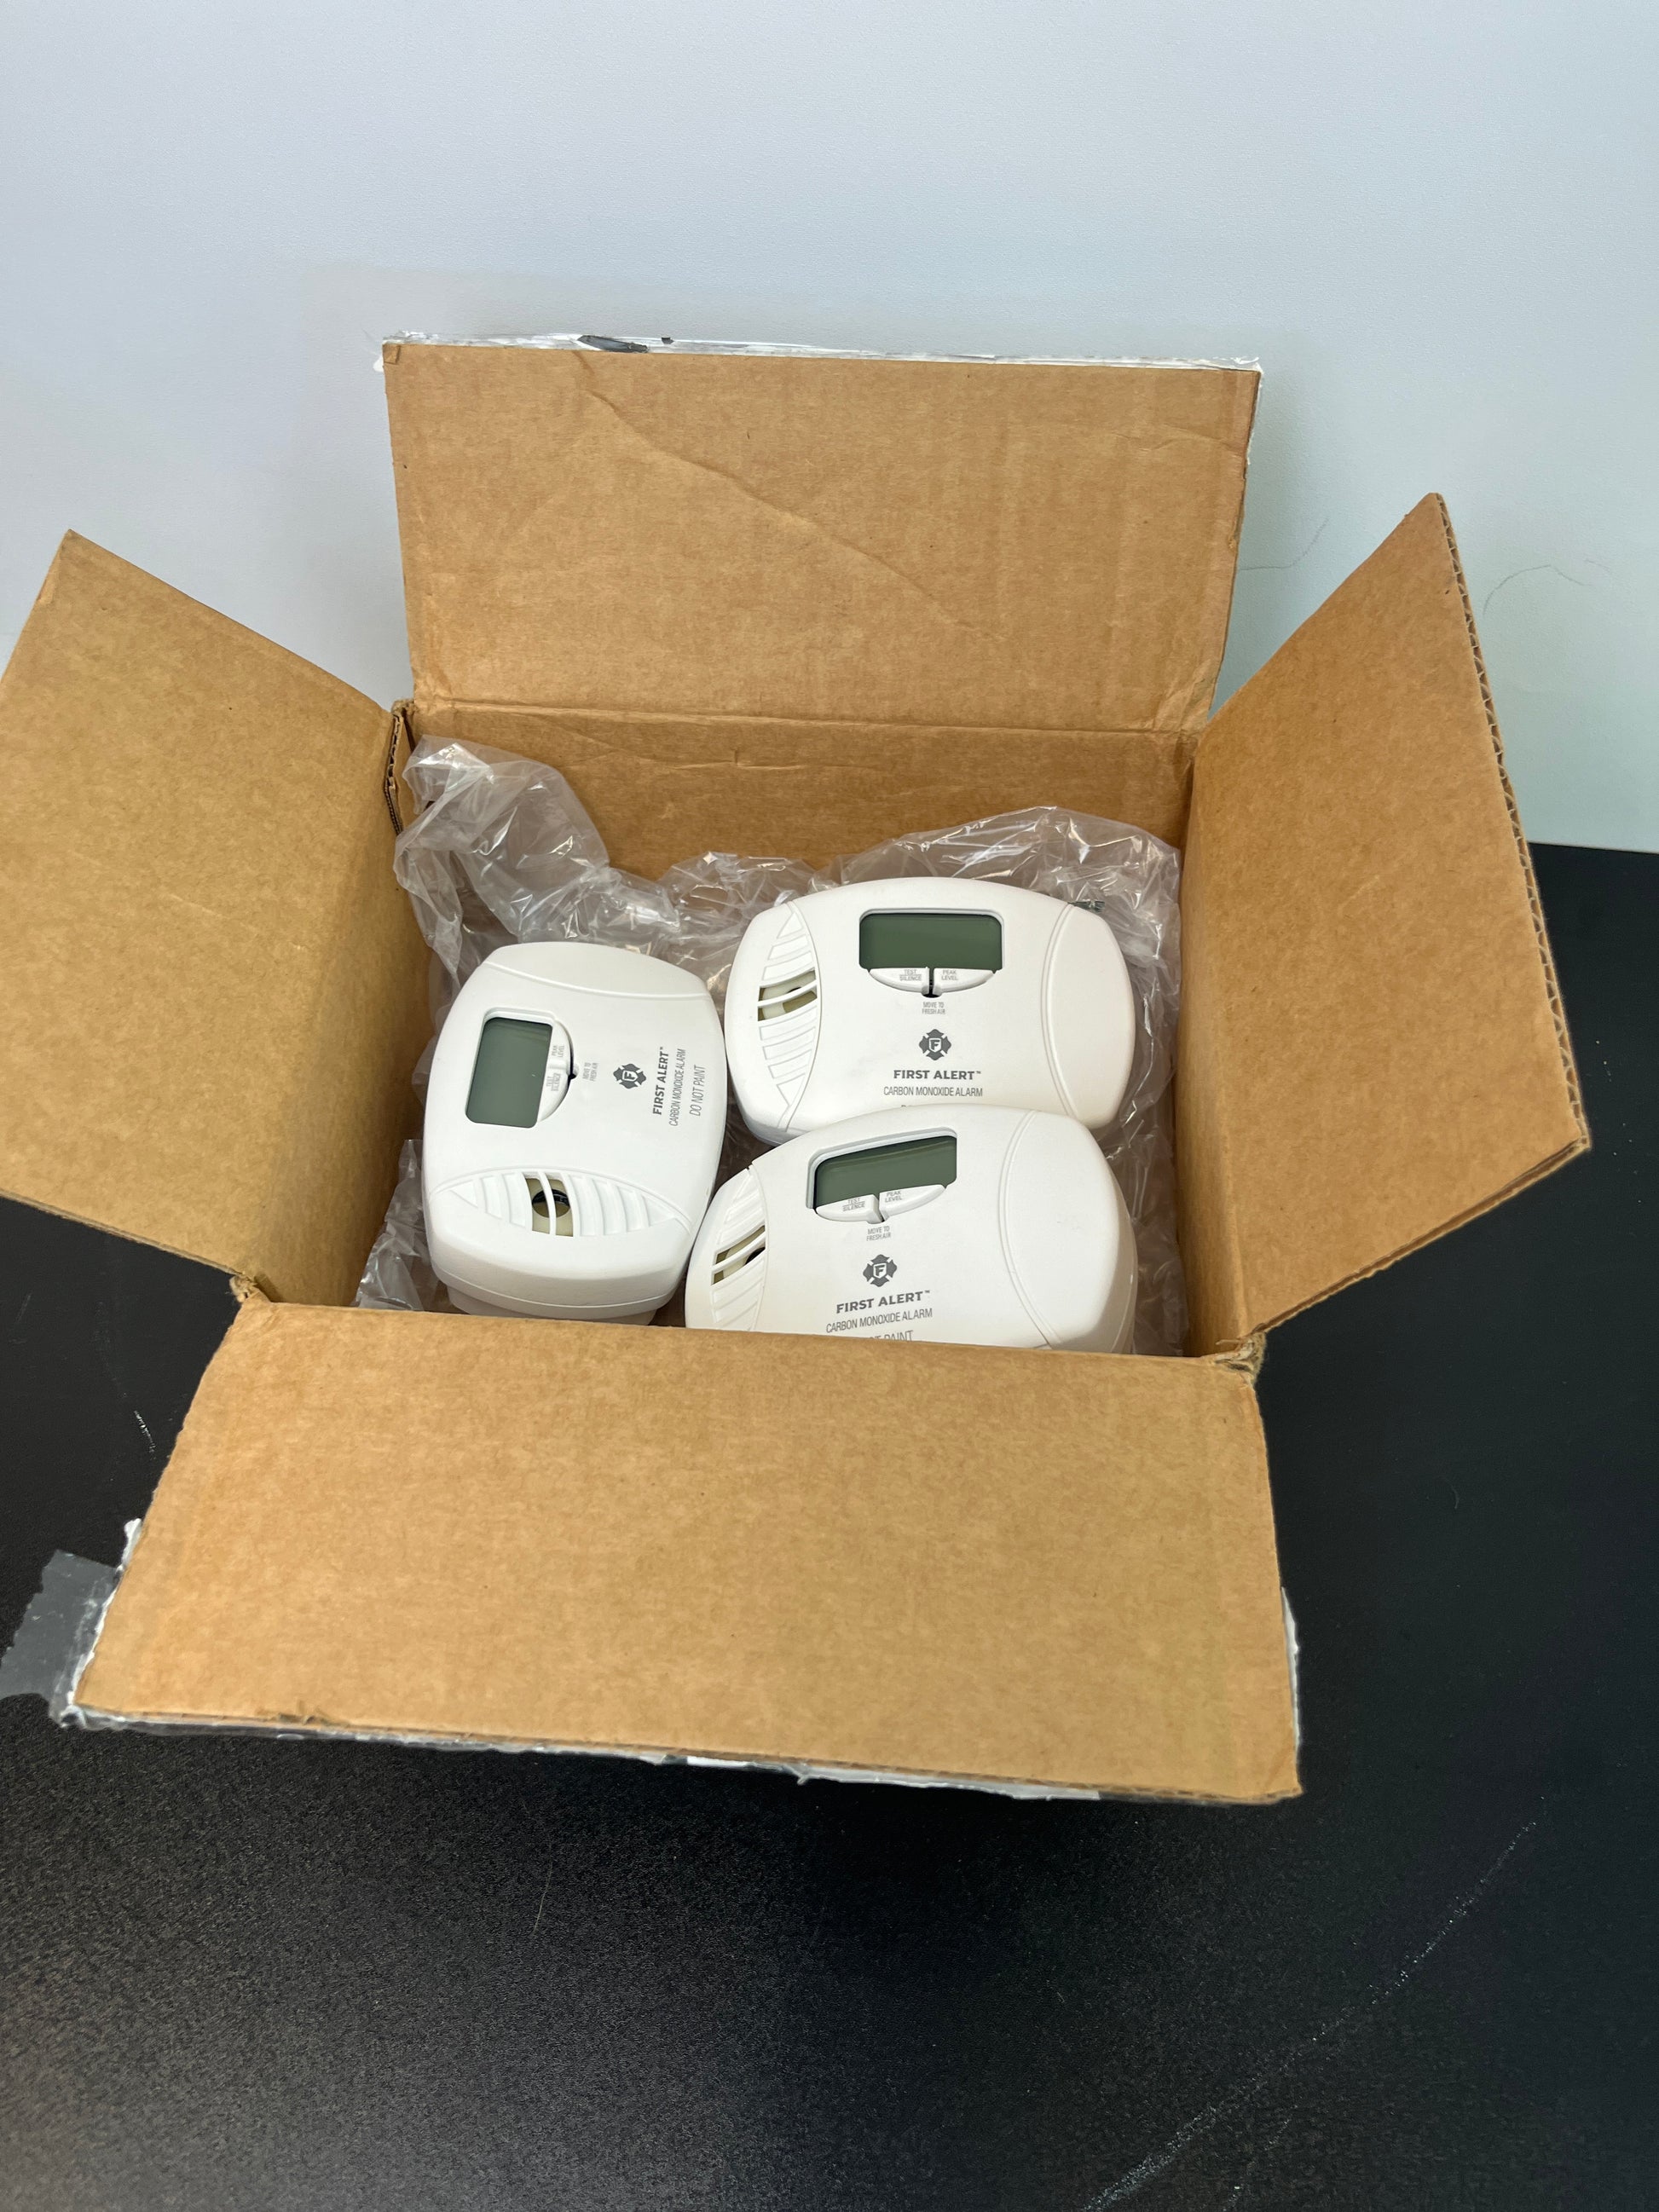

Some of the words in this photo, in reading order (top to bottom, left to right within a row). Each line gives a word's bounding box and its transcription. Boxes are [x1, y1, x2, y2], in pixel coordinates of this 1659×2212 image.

[676, 1048, 686, 1070] ALARM
[692, 1064, 706, 1087] PAINT
[893, 1070, 930, 1079] FIRST
[673, 1069, 685, 1100] MONOXIDE
[883, 1086, 914, 1096] CARBON
[916, 1087, 955, 1096] MONOXIDE
[954, 1087, 983, 1097] ALARM
[652, 1084, 665, 1116] FIRST
[691, 1086, 704, 1103] NOT
[668, 1100, 680, 1127] CARBON
[689, 1104, 702, 1117] DO
[842, 1202, 865, 1212] SILENCE
[866, 1233, 882, 1242] FRESH
[867, 1227, 882, 1235] MOVE
[835, 1298, 875, 1314] FIRST
[826, 1319, 858, 1333] CARBON
[859, 1312, 901, 1327] MONOXIDE
[901, 1308, 933, 1320] ALARM
